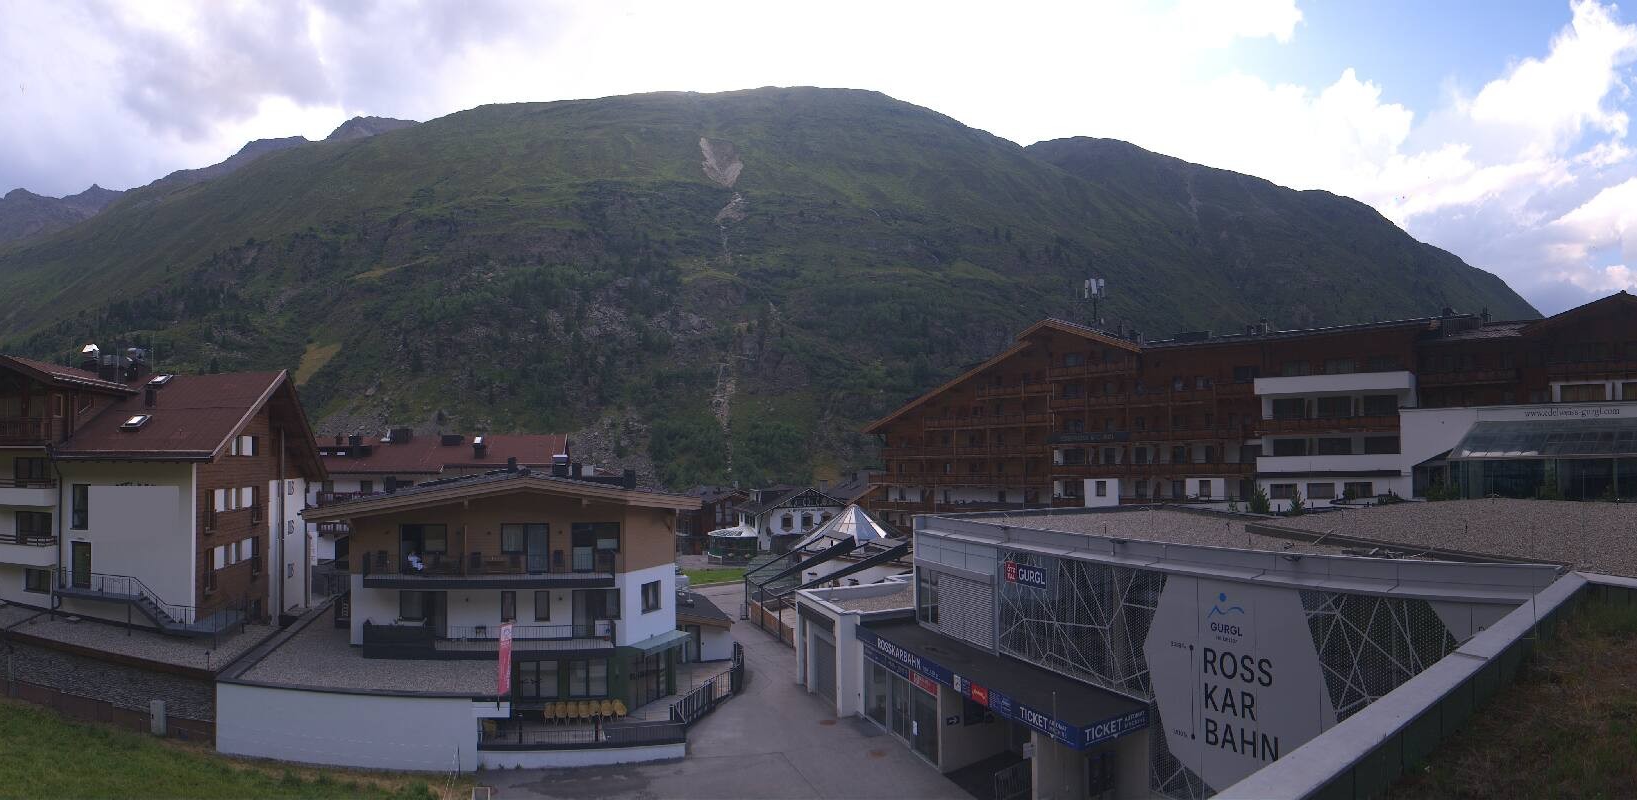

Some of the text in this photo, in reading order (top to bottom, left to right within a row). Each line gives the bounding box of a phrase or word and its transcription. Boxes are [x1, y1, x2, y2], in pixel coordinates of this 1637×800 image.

[1018, 568, 1046, 585] GURGL
[1210, 622, 1243, 637] GURGL
[877, 637, 921, 670] ROSSKARBAHN
[1204, 647, 1273, 687] ROSS
[1204, 683, 1257, 721] KAR
[1019, 706, 1048, 730] TICKET
[1084, 718, 1123, 742] TICKET
[1205, 718, 1279, 762] BAHN
